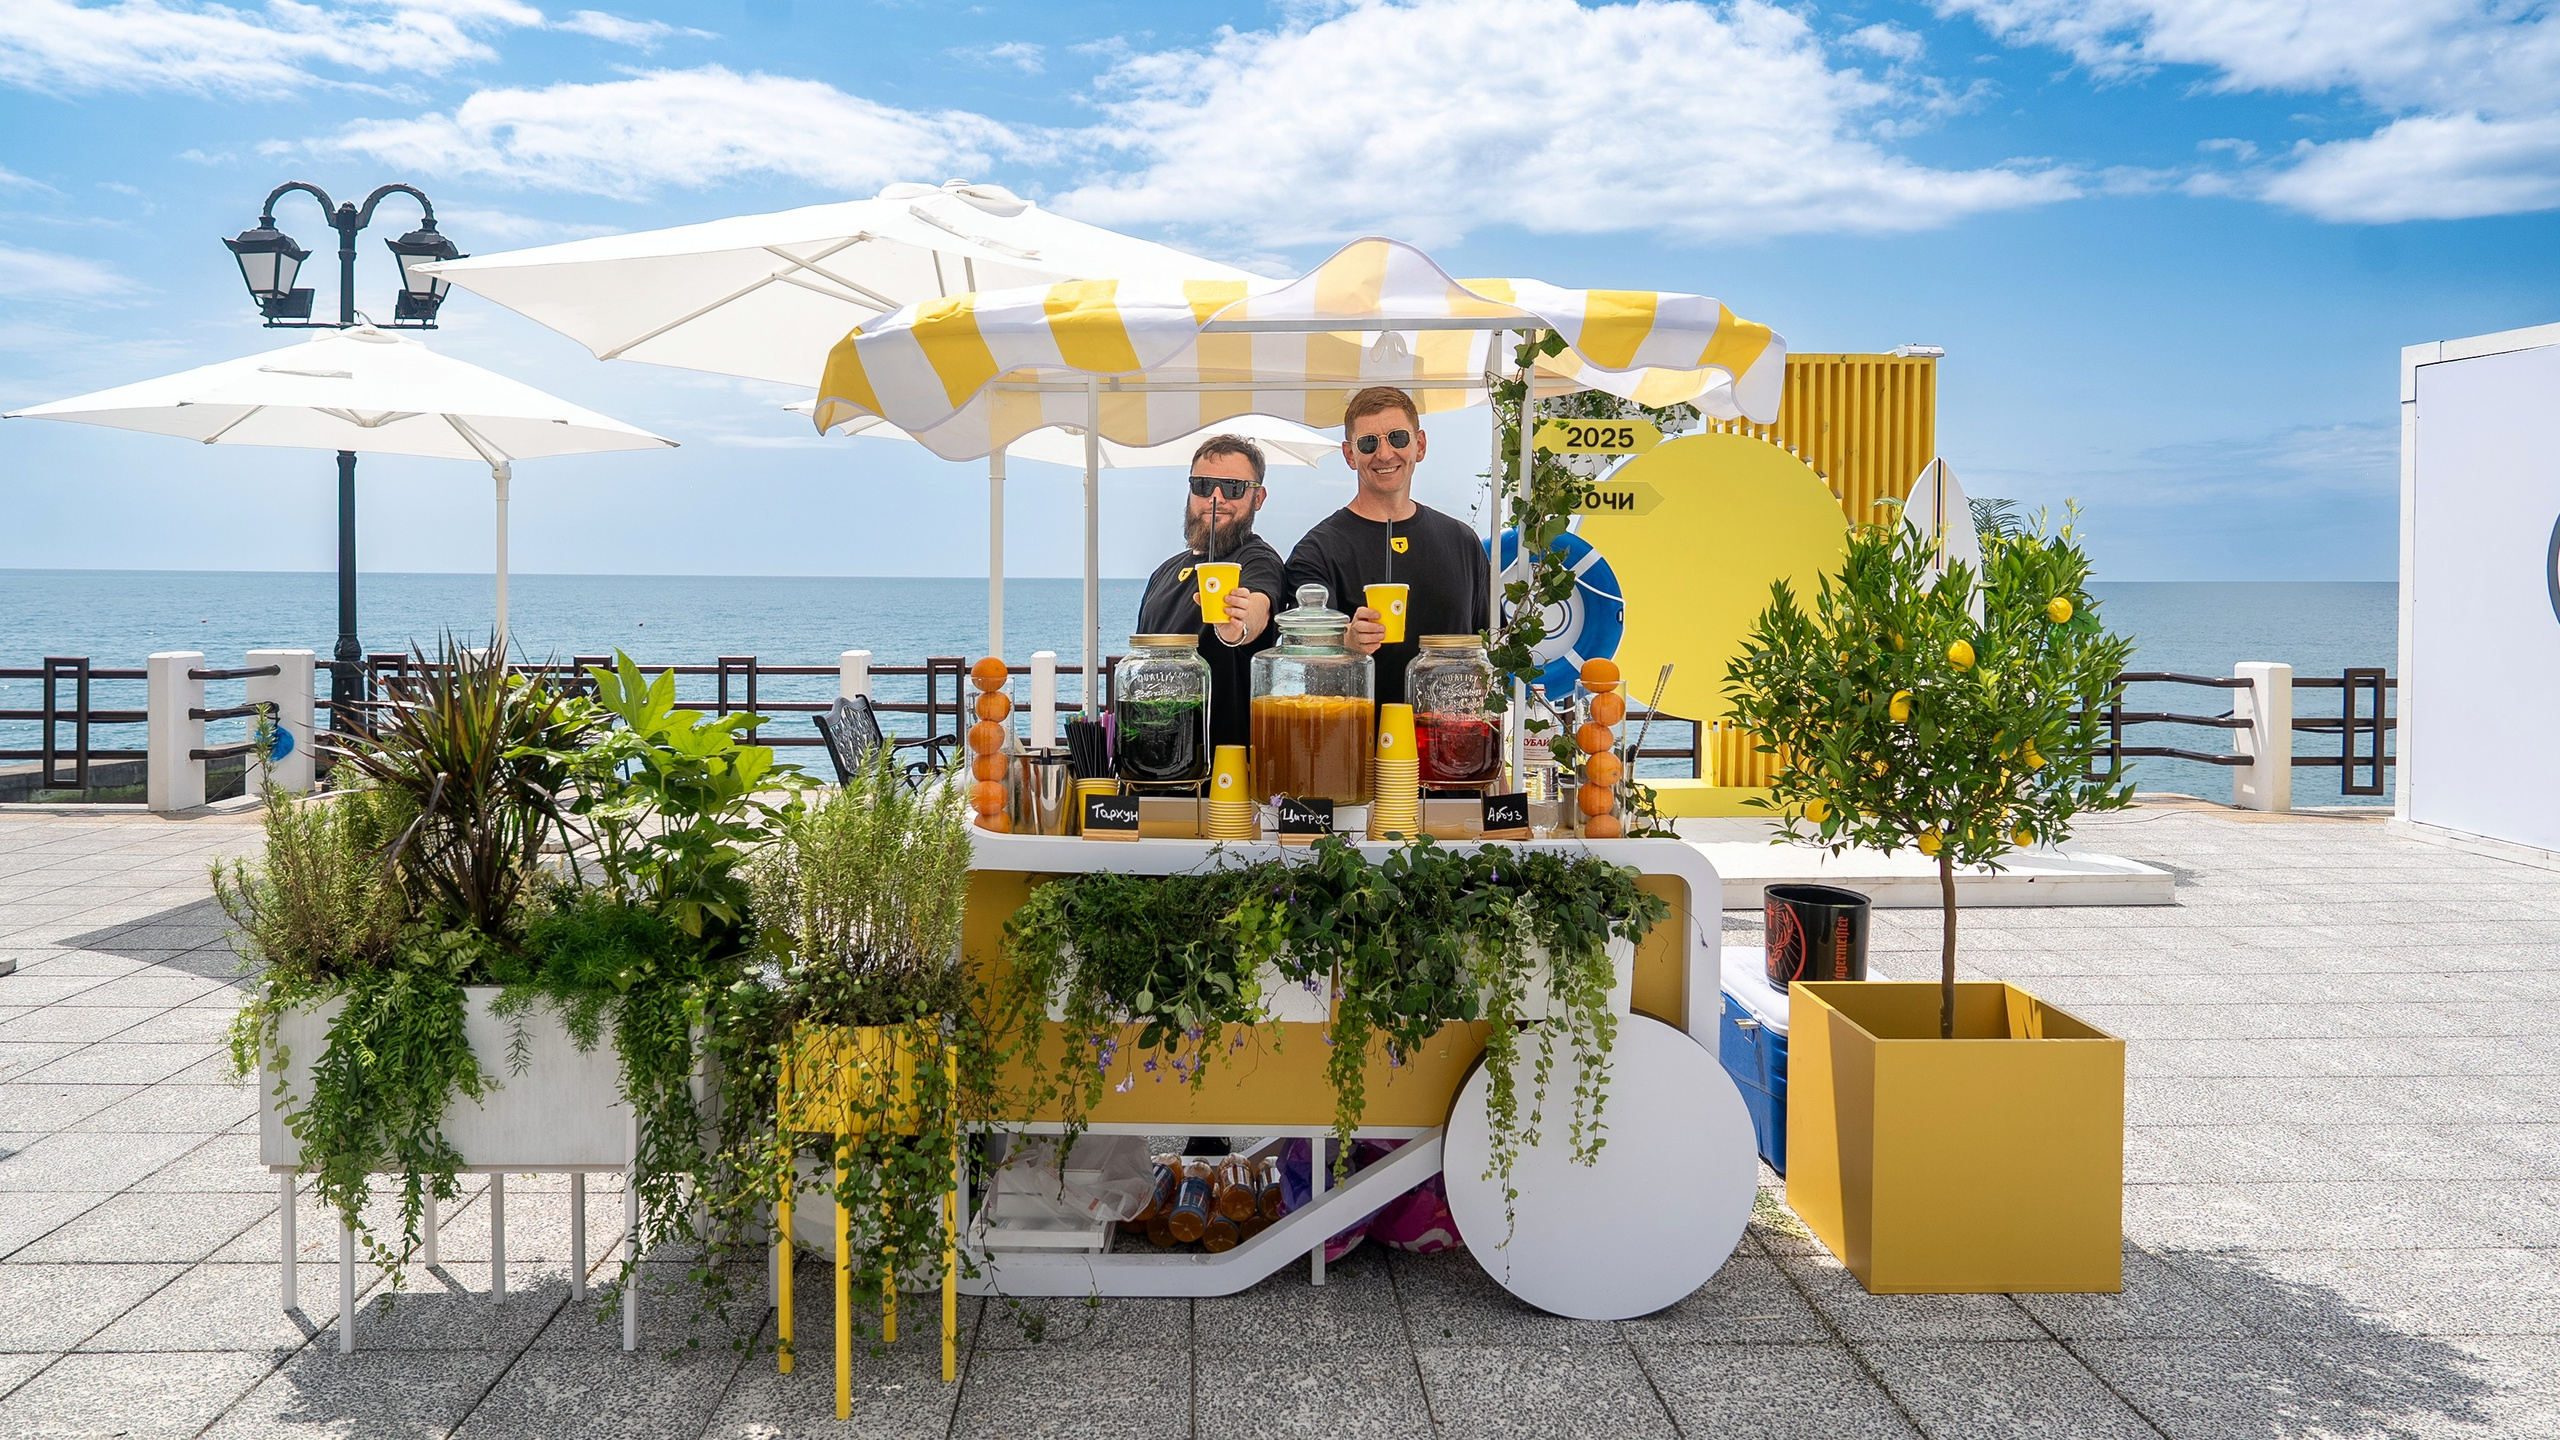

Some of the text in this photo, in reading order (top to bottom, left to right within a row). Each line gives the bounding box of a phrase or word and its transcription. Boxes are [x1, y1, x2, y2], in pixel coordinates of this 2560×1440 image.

[1566, 427, 1634, 448] 2025
[1091, 802, 1139, 823] Тархун
[1282, 807, 1331, 825] Цитрус
[1487, 805, 1523, 822] Арбуз
